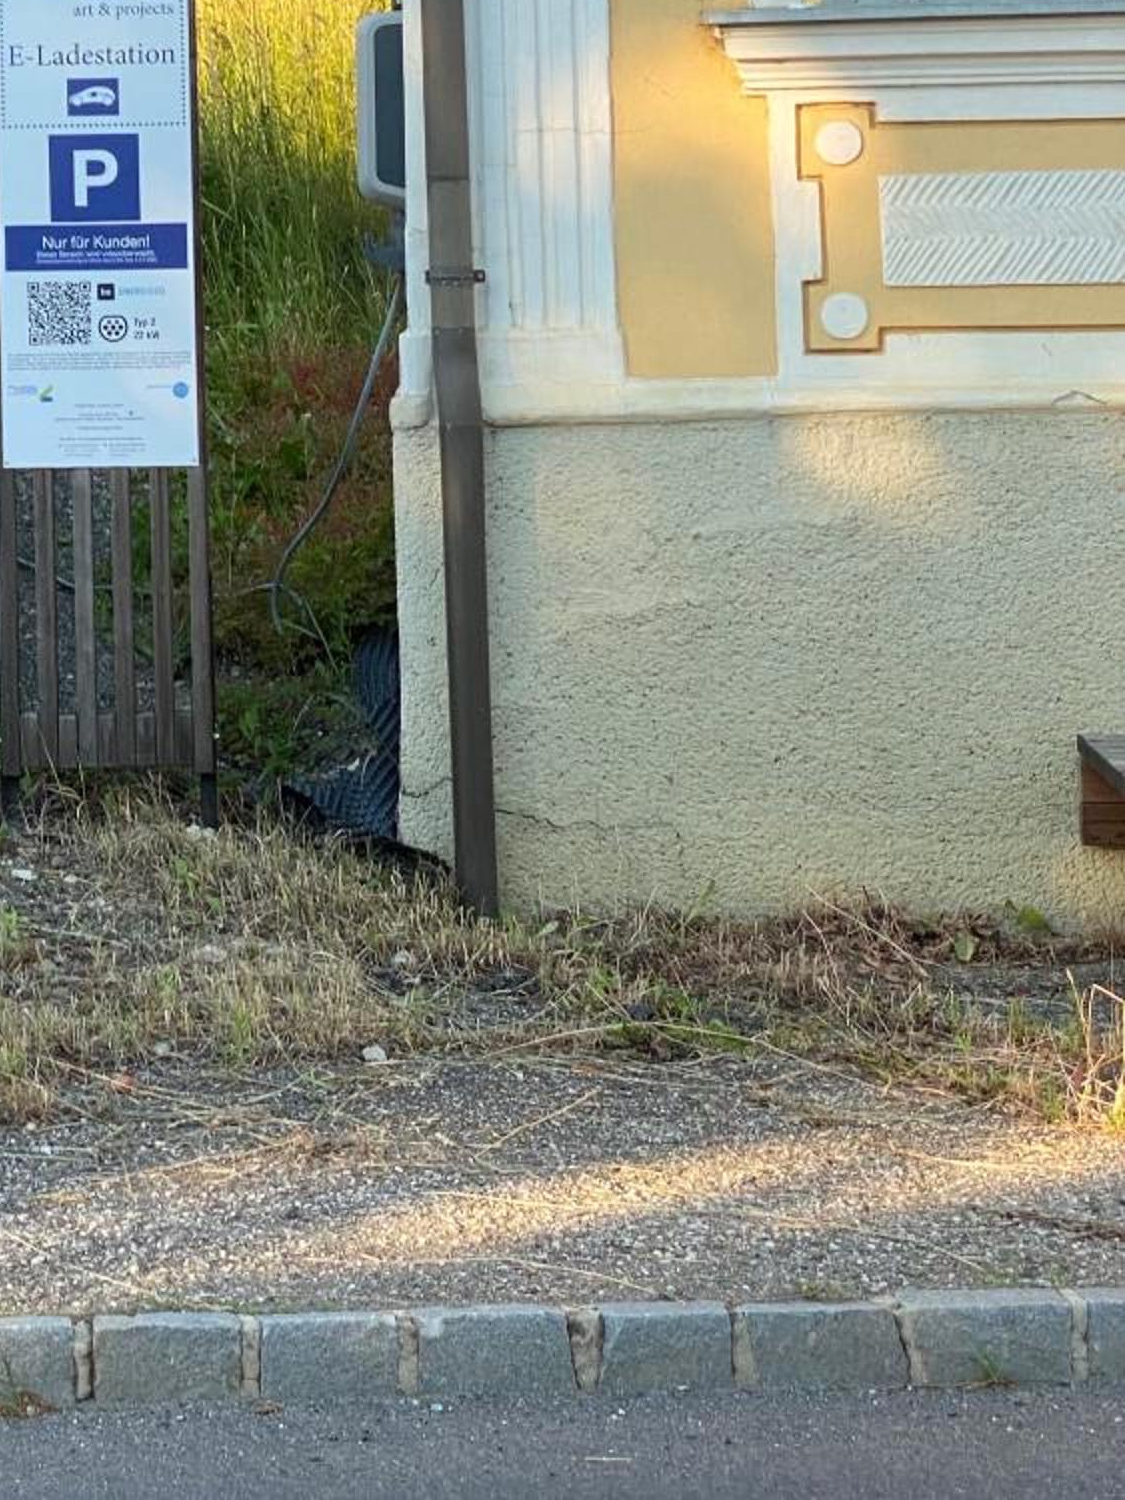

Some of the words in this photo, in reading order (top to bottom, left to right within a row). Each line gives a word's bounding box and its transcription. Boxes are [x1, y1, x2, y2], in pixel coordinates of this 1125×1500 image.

[73, 3, 94, 18] art
[98, 3, 112, 17] &
[115, 1, 175, 20] projects
[8, 43, 176, 67] E-Ladestation
[72, 148, 119, 208] P
[42, 235, 68, 250] Nur
[71, 234, 91, 249] für
[93, 233, 150, 249] Kunden!
